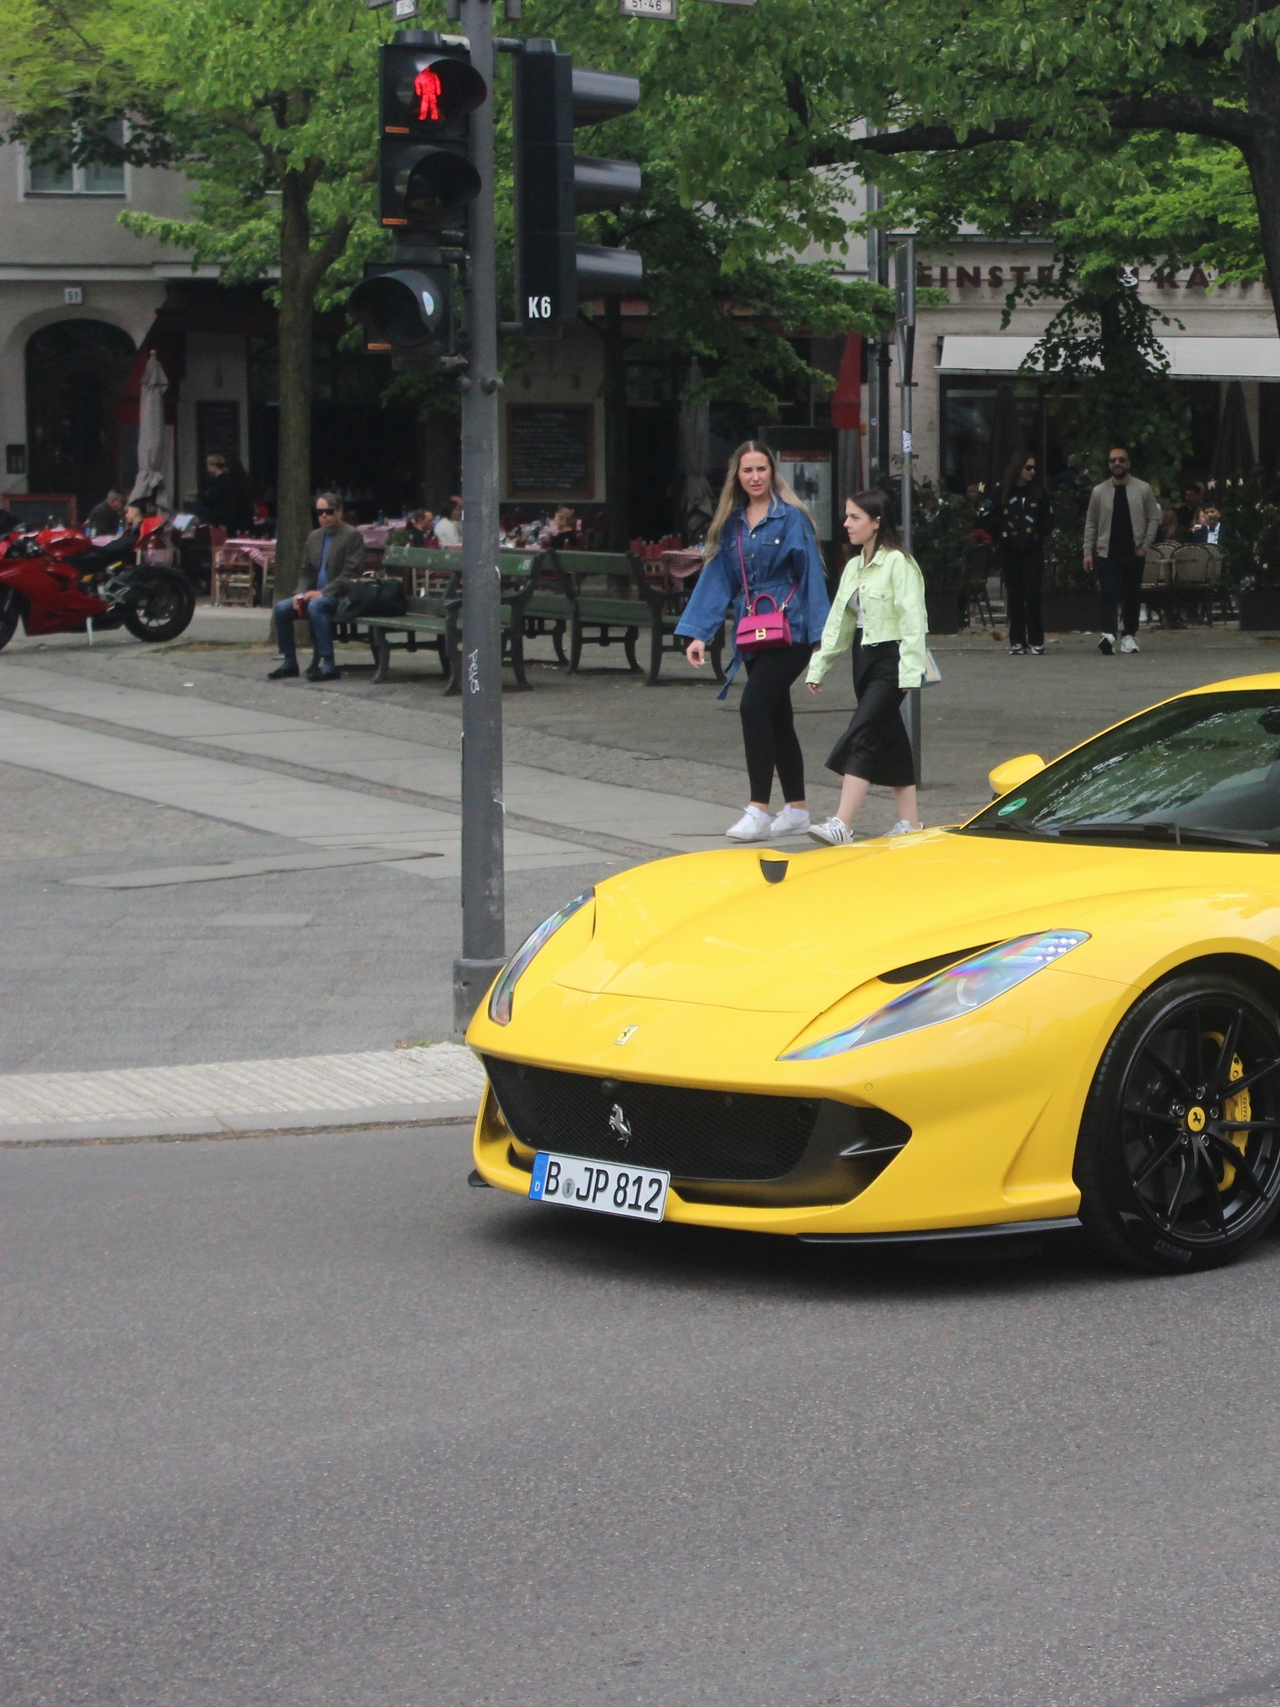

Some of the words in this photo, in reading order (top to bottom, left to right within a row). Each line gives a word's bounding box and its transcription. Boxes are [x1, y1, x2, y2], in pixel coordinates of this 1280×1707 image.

[528, 295, 552, 318] K6
[755, 628, 767, 641] B
[534, 1181, 541, 1192] D
[544, 1161, 562, 1196] B
[575, 1167, 609, 1204] JP
[613, 1172, 662, 1214] 812
